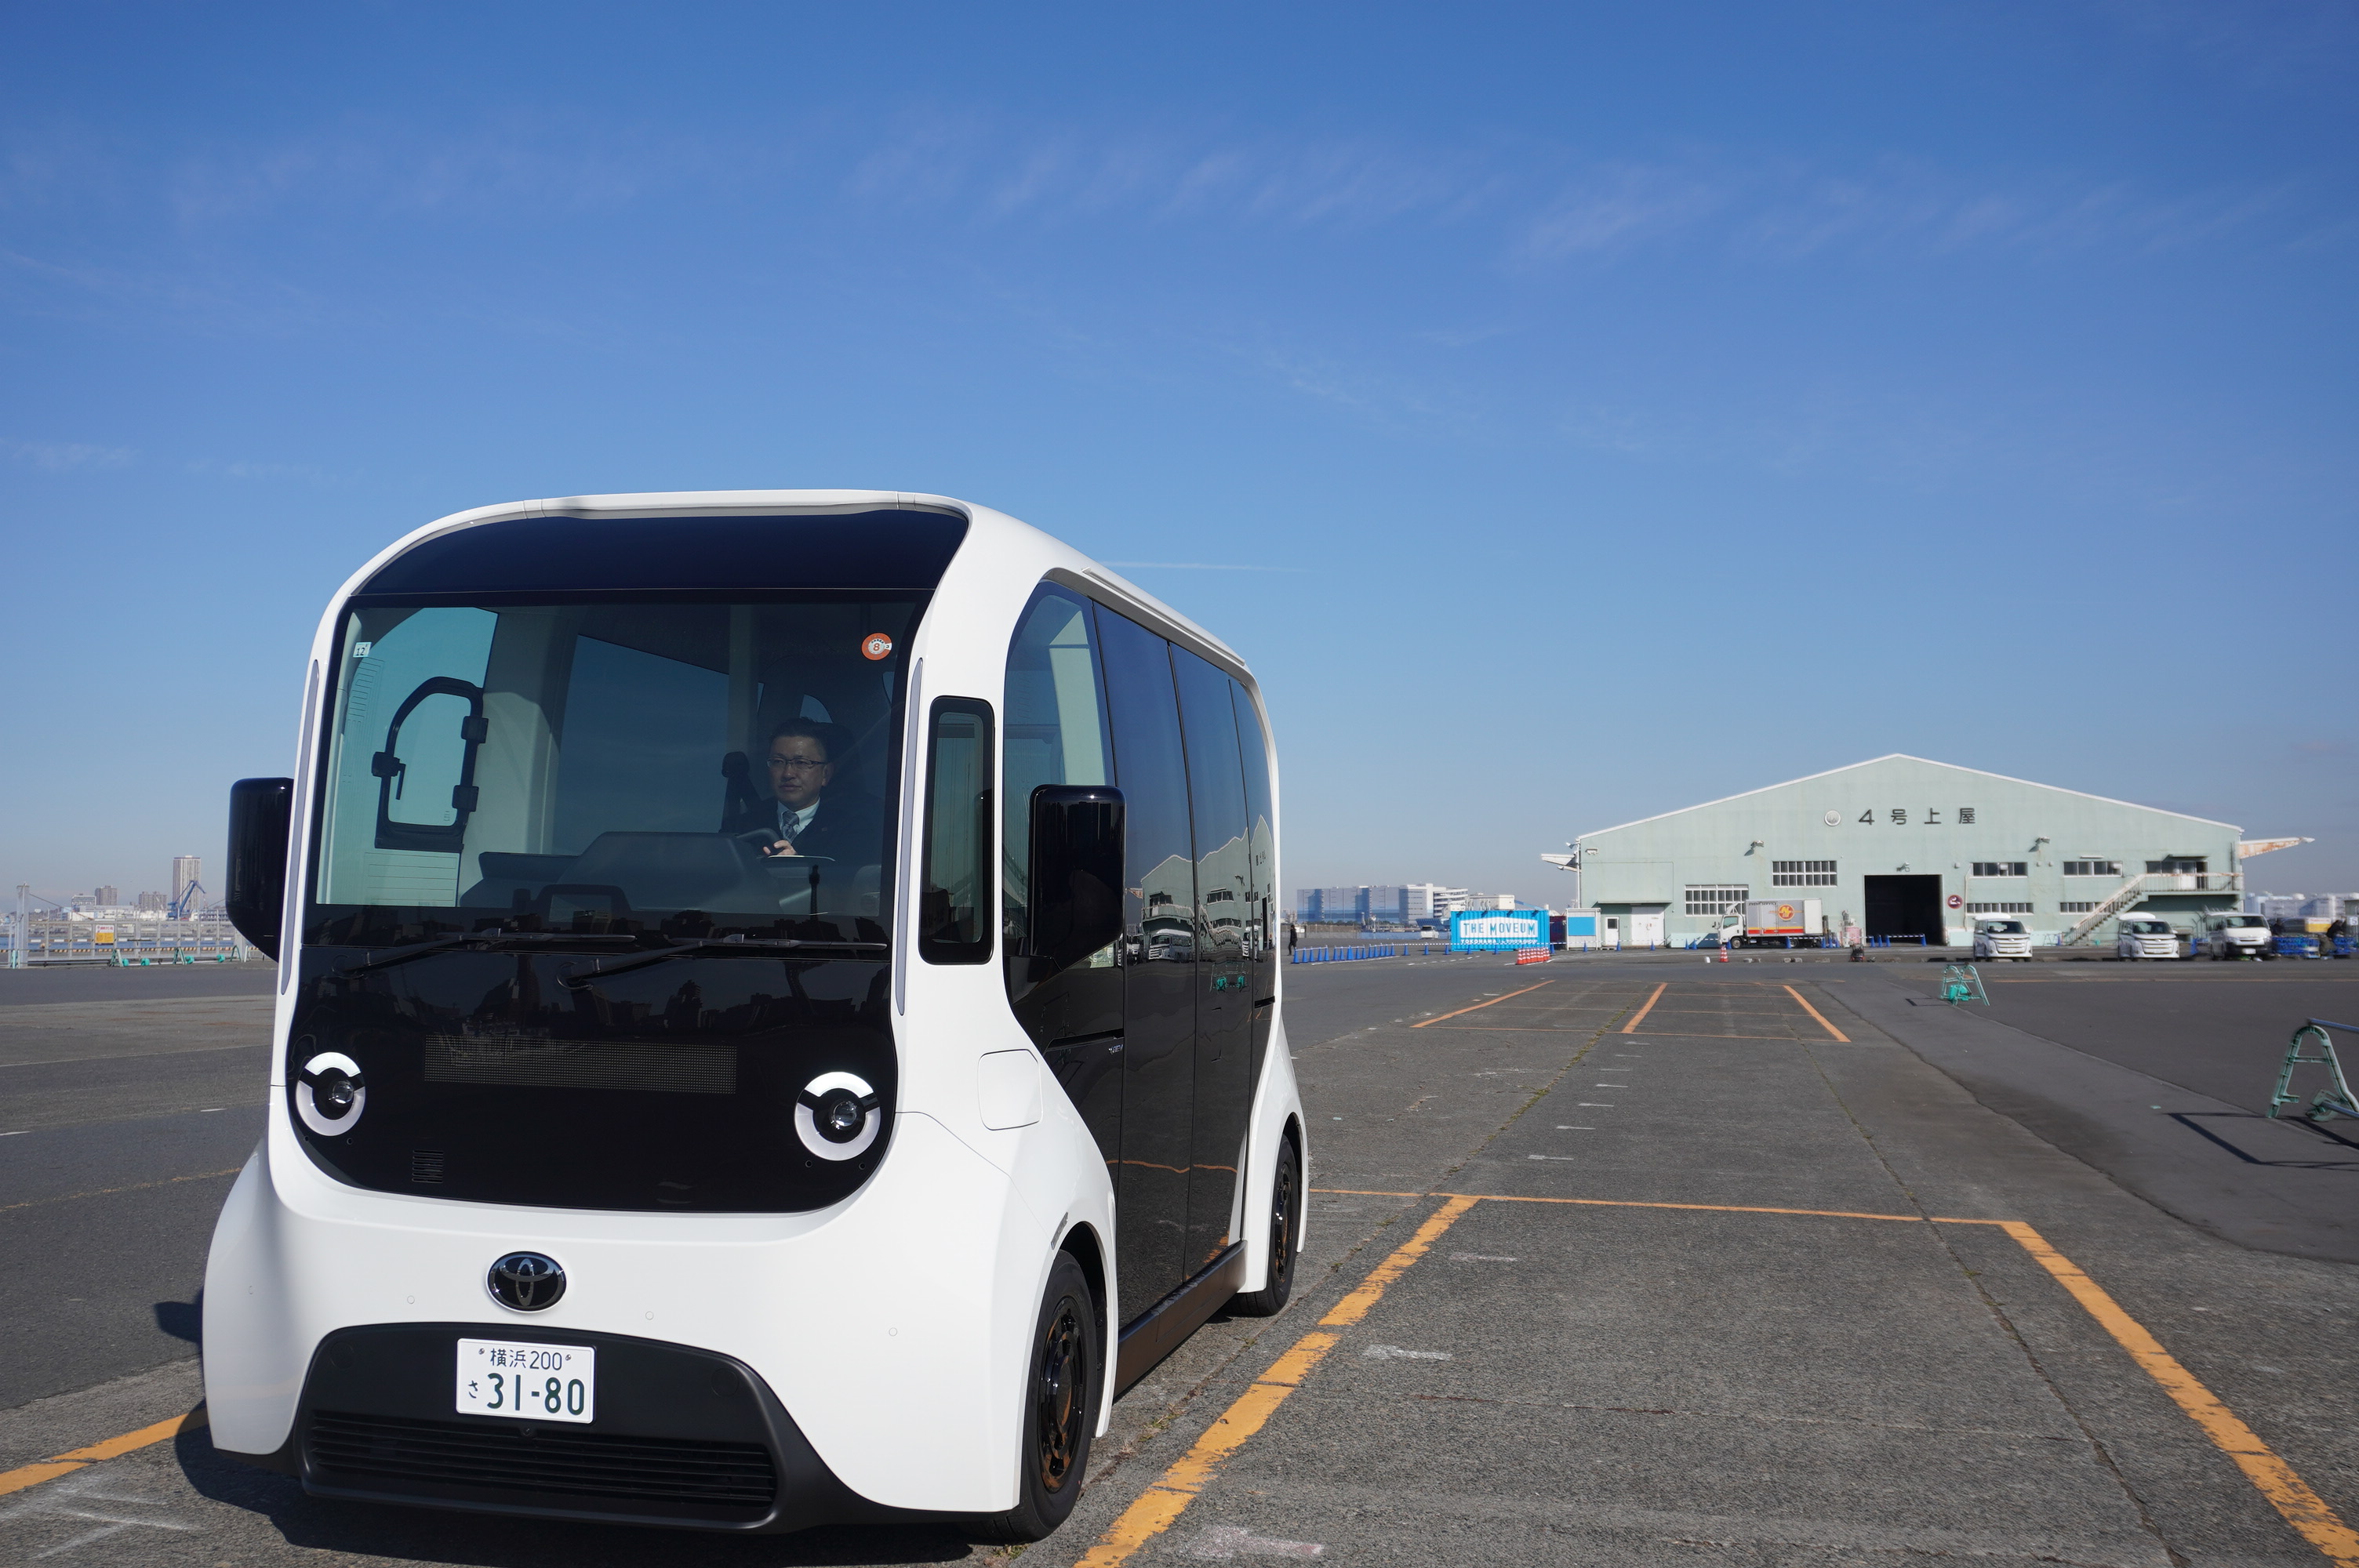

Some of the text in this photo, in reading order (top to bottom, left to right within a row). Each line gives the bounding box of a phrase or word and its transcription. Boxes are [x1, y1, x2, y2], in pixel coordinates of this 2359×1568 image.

[355, 647, 365, 656] 12
[1858, 808, 1976, 826] 4号上屋
[1463, 923, 1536, 936] THE MOVEUM
[468, 1373, 585, 1416] さ 31-80
